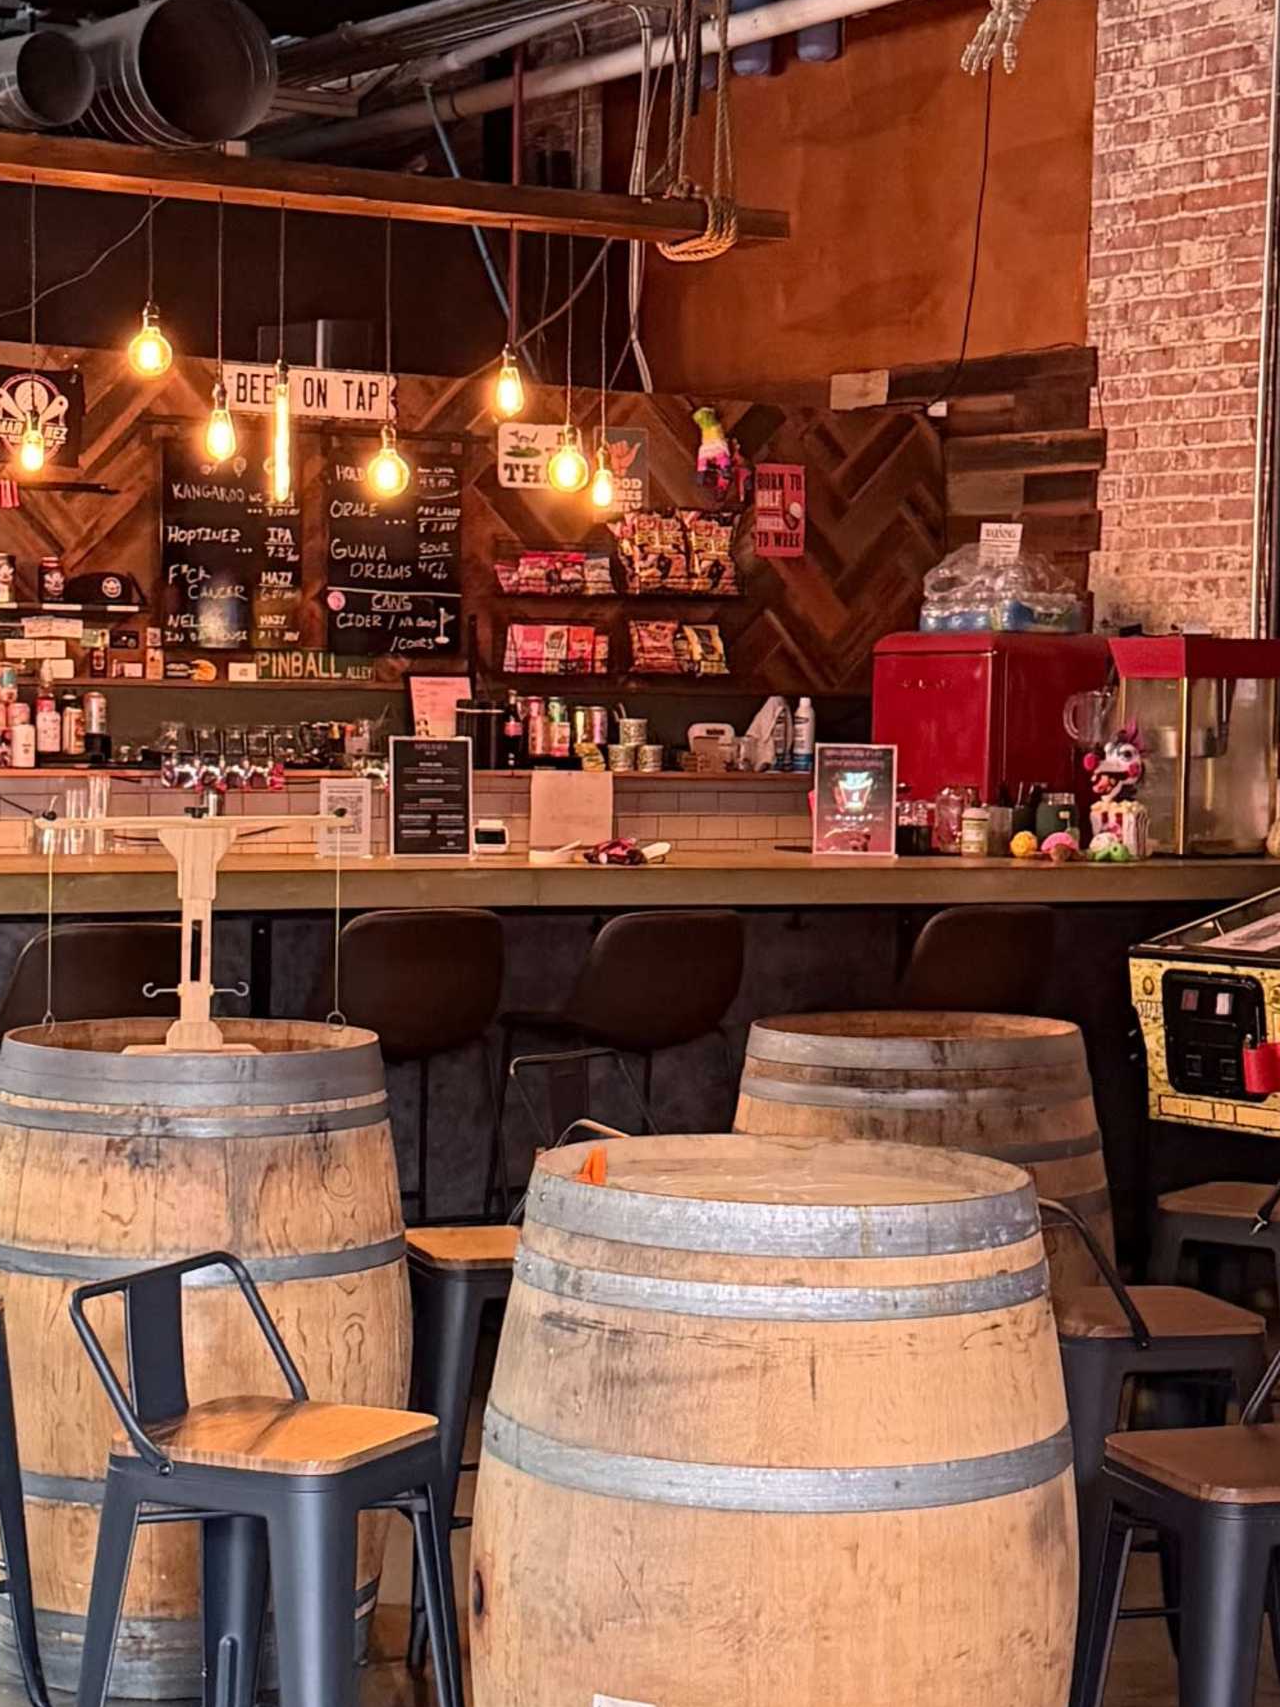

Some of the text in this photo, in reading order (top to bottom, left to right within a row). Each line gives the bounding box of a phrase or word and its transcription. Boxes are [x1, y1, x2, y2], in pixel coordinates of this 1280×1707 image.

[236, 372, 380, 411] BEE ON TAP
[172, 483, 245, 503] KANGAROO
[329, 499, 378, 518] ORALE
[266, 527, 293, 543] IPA
[773, 532, 801, 548] WORK
[330, 538, 387, 560] GUAVA
[350, 562, 413, 580] DREAMS
[371, 594, 413, 610] CANS
[336, 612, 382, 629] CIDER
[257, 652, 373, 680] PINBALL ALLEY
